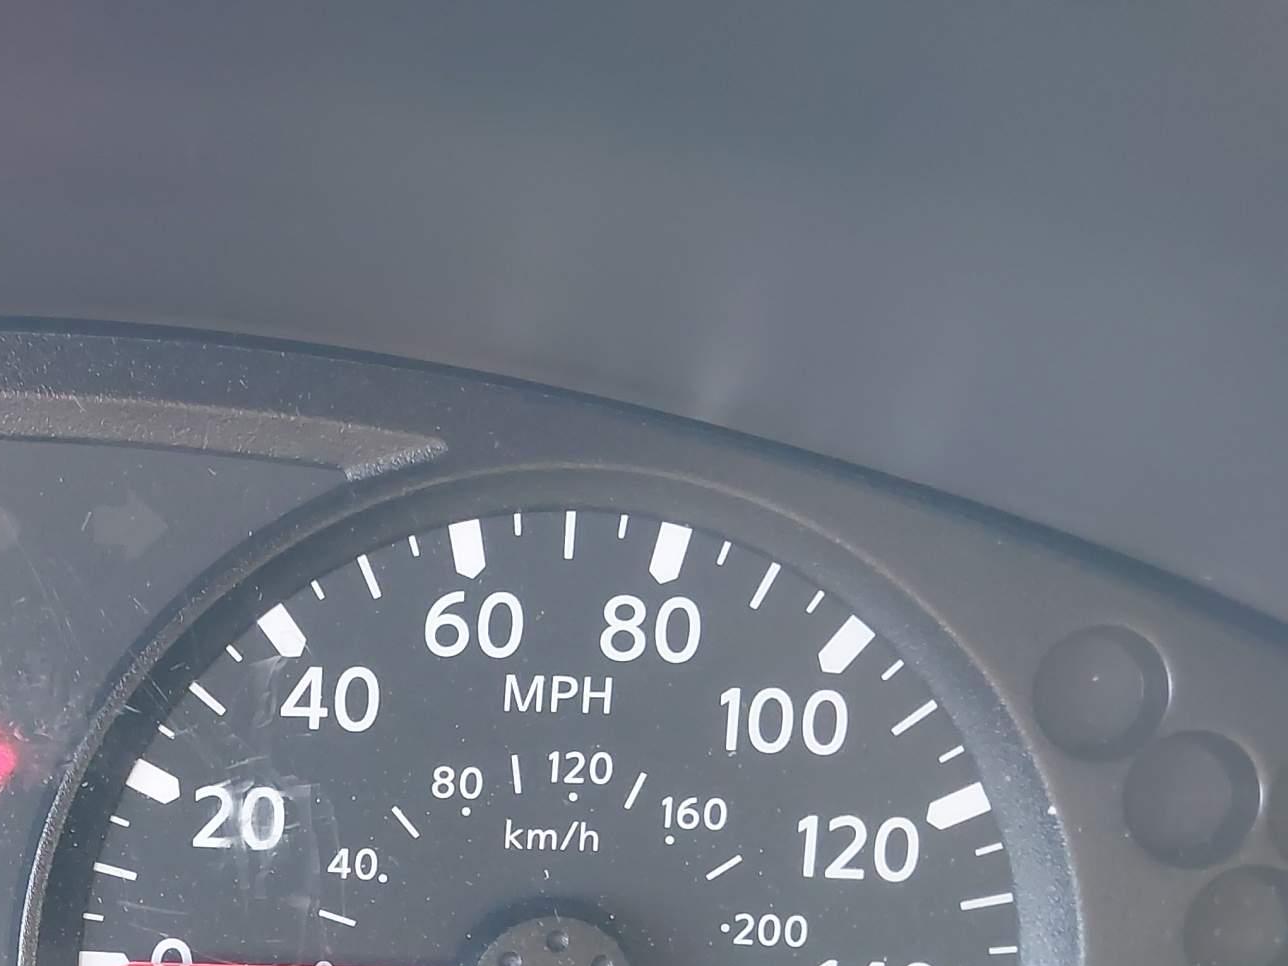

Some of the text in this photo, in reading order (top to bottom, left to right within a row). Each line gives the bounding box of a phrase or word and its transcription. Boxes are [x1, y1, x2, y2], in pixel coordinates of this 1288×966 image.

[424, 590, 524, 659] 60
[599, 594, 701, 664] 80
[280, 666, 380, 732] 40
[503, 674, 613, 714] MPH
[720, 687, 848, 756] 100
[431, 765, 483, 800] 80
[548, 750, 613, 785] 120
[192, 785, 285, 851] 20
[504, 818, 599, 852] km/h
[661, 796, 728, 831] 160
[797, 814, 920, 883] 120
[733, 912, 808, 948] 200
